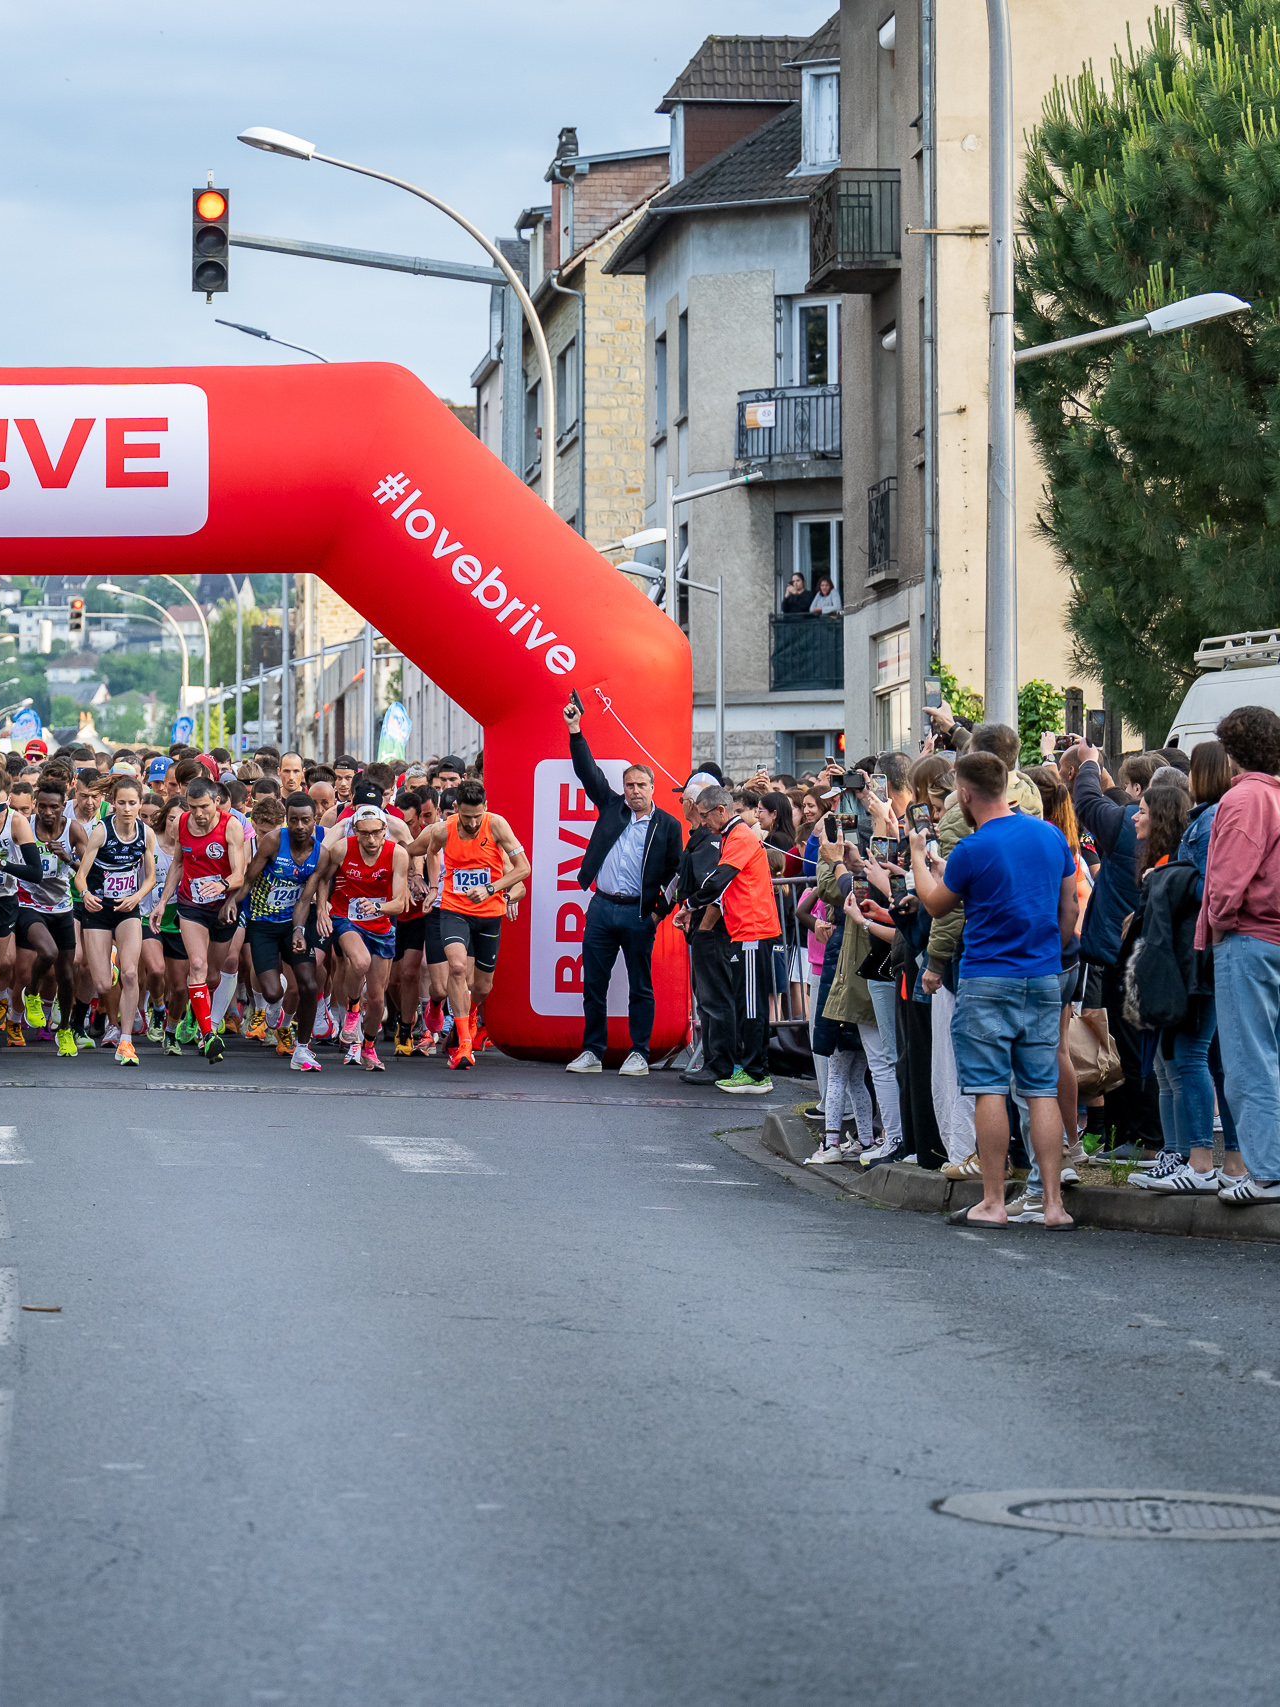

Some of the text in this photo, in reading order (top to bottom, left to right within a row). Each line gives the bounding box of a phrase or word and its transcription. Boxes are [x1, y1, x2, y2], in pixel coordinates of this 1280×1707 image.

[372, 471, 576, 675] #lovebrive
[107, 875, 135, 891] 2578
[455, 872, 488, 886] 1250
[274, 888, 301, 901] 1241
